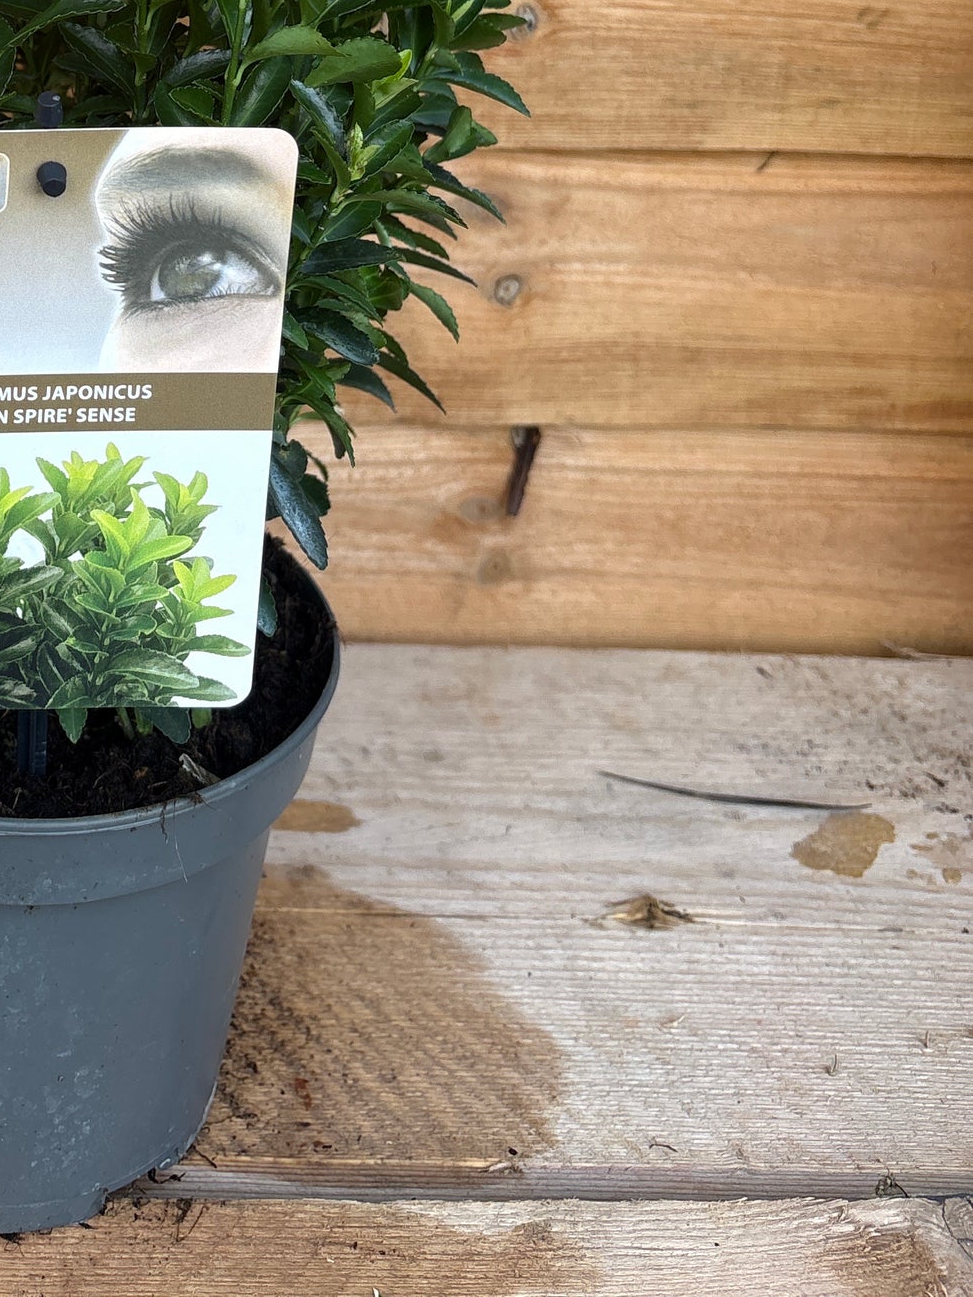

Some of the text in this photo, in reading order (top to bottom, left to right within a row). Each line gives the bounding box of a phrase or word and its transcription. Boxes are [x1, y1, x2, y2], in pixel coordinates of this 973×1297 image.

[42, 384, 153, 401] JAPONICUS
[13, 408, 72, 424] SPIRE'
[76, 407, 136, 422] SENSE
